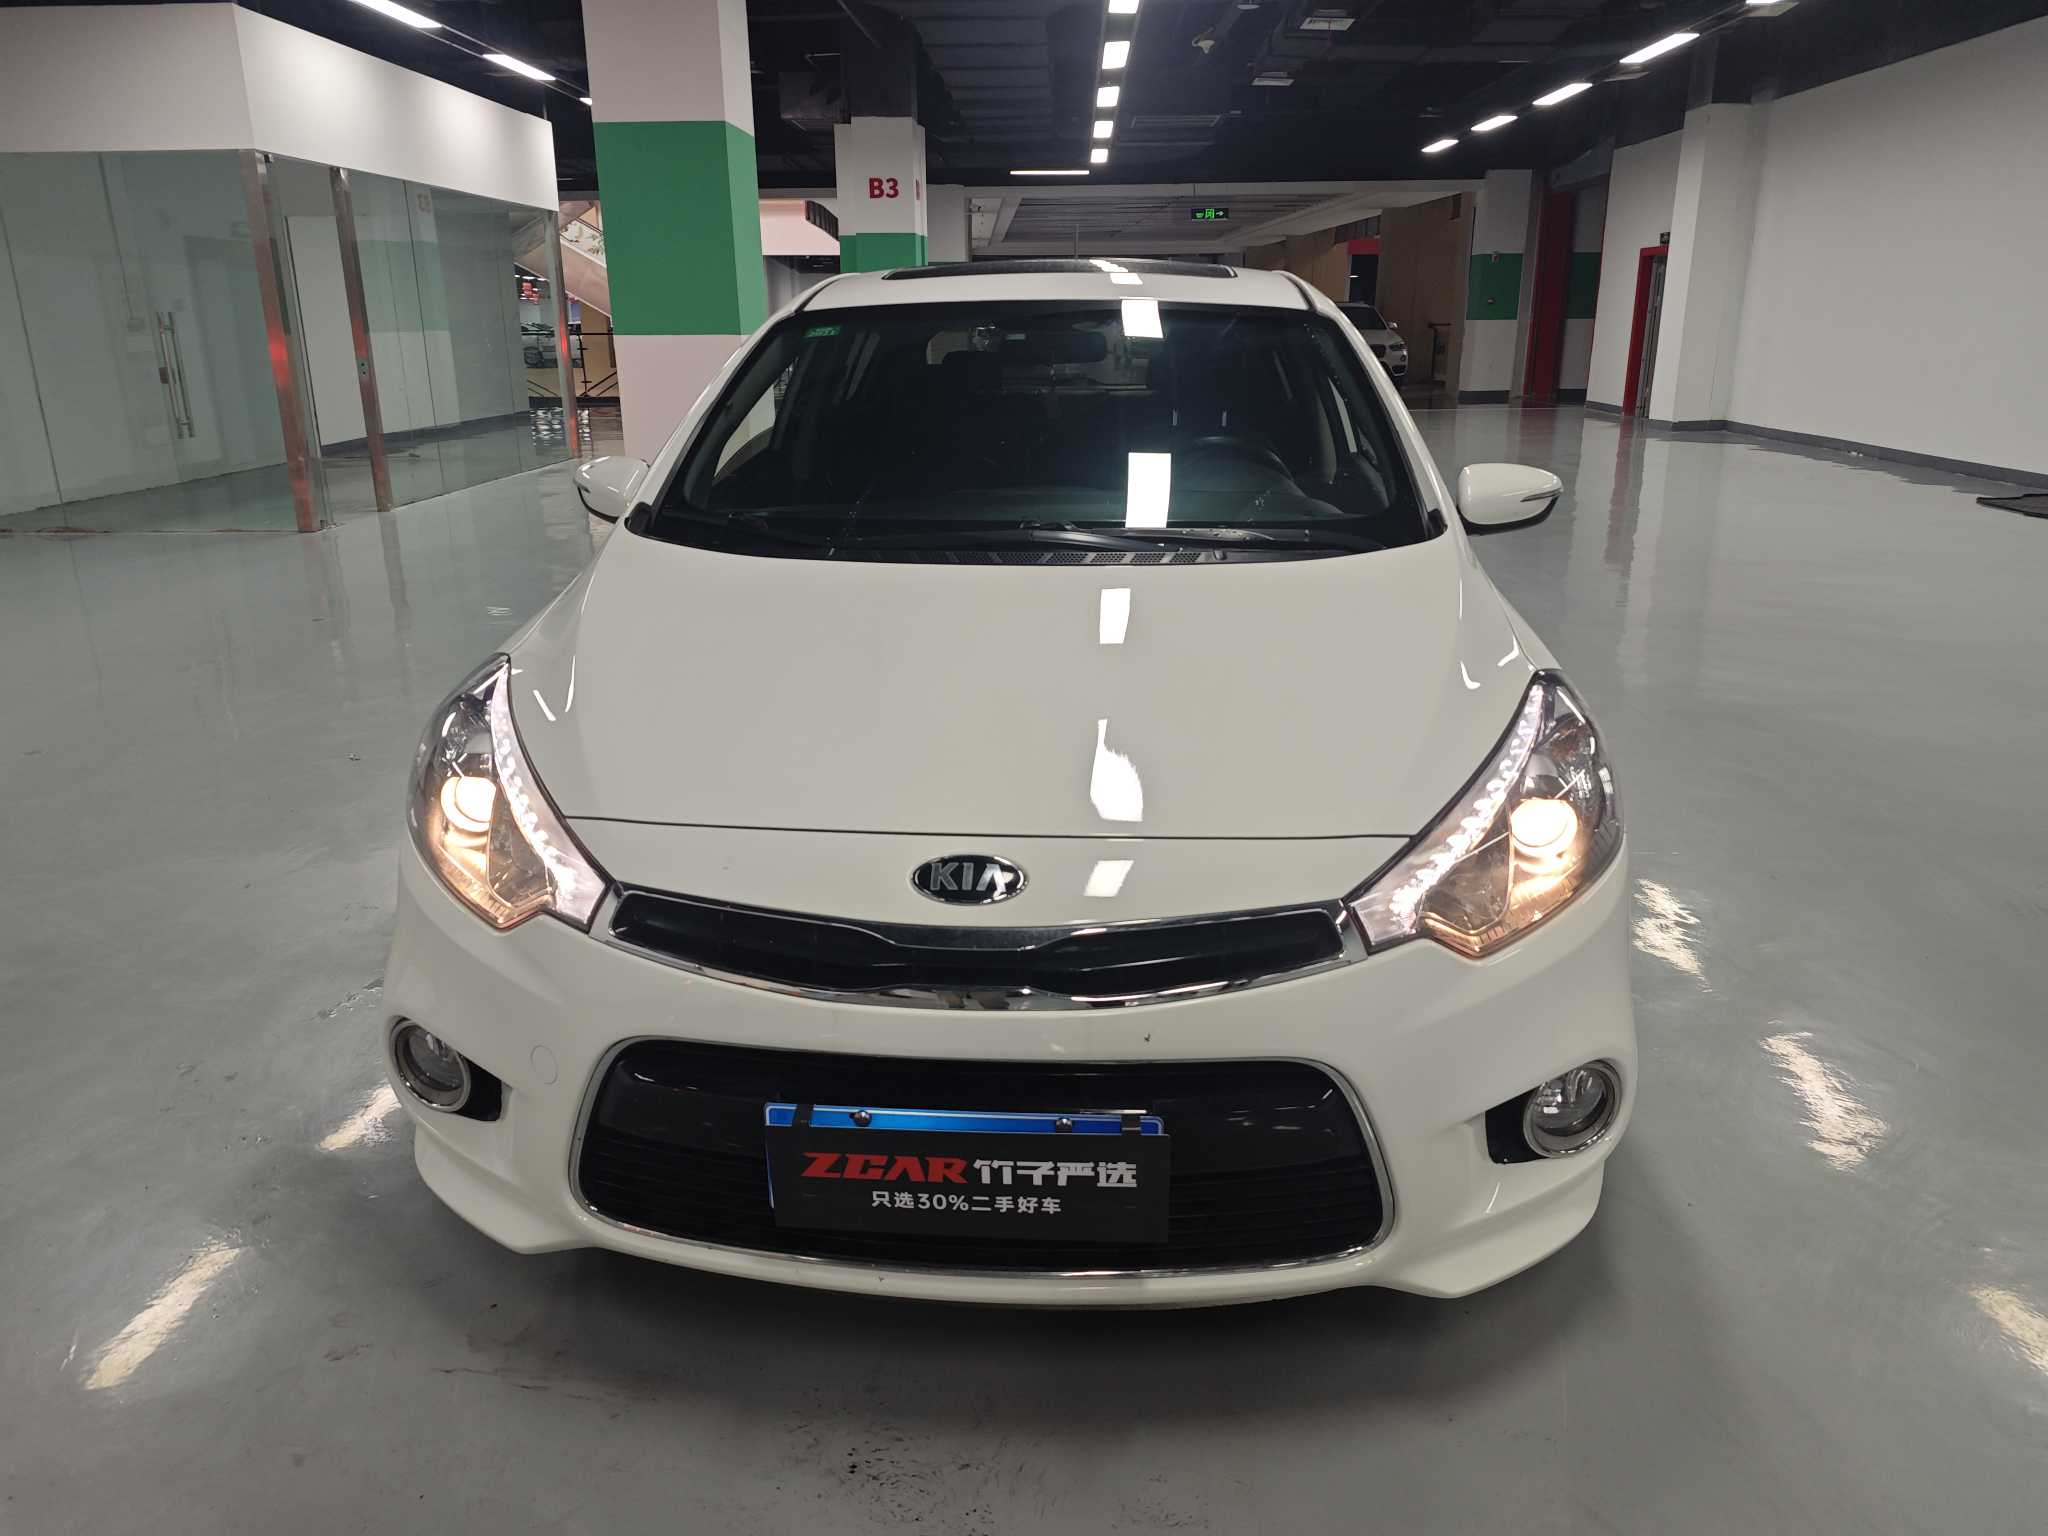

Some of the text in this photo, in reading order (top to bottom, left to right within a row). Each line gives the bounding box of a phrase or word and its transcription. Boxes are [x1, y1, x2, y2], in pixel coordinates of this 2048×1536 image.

[869, 178, 900, 199] B3
[930, 862, 1006, 891] KIA
[801, 1152, 1137, 1188] ZCAR 竹子严选
[871, 1190, 1061, 1214] 只选30%二手好车
